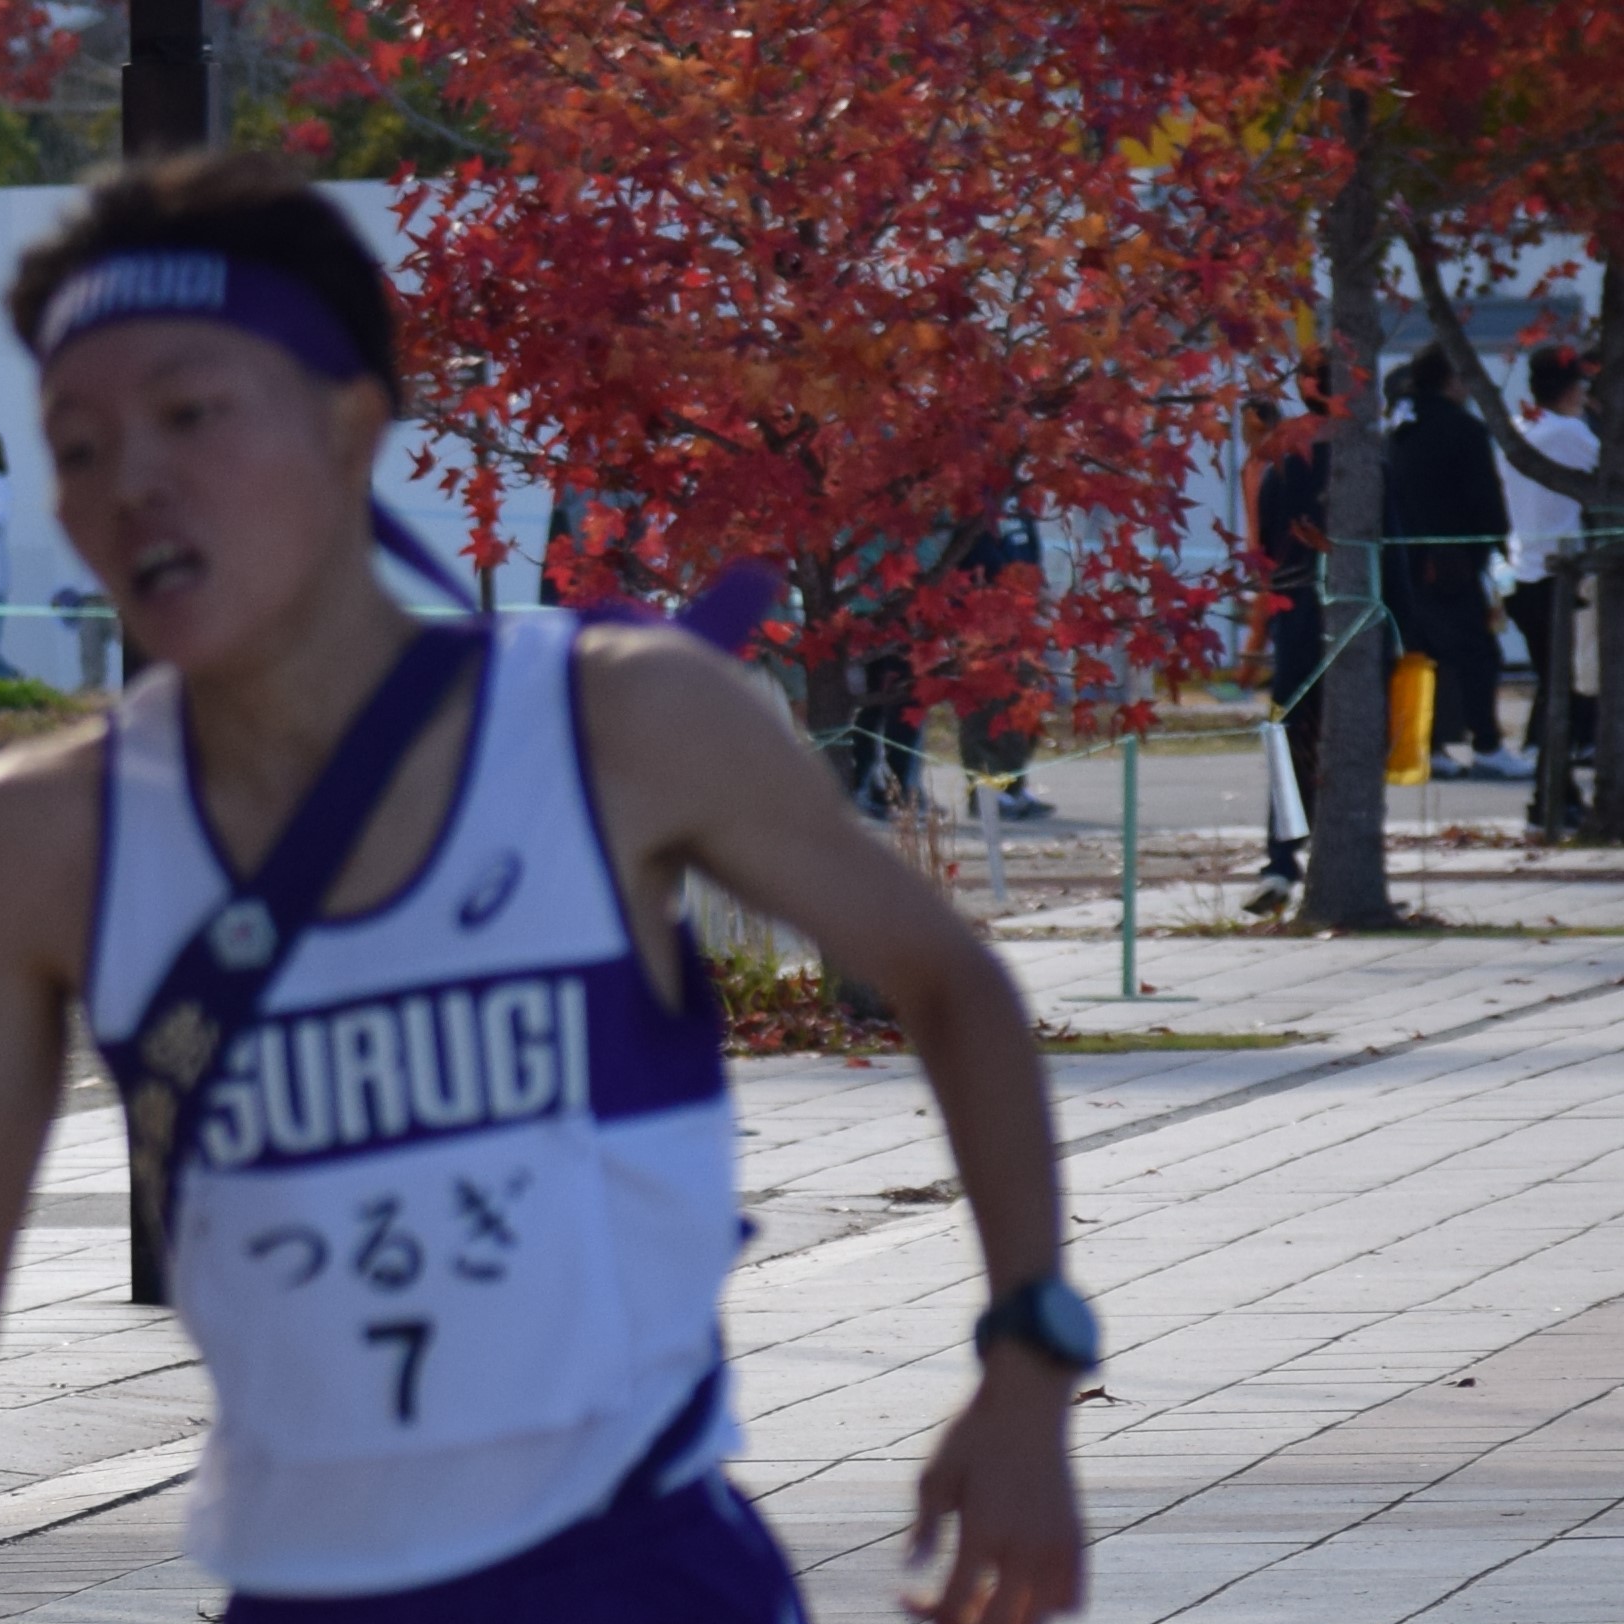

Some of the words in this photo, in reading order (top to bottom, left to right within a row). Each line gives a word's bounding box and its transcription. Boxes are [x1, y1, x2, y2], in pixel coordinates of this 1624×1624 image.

[248, 1167, 533, 1295] つるぎ
[363, 1317, 434, 1426] 7
